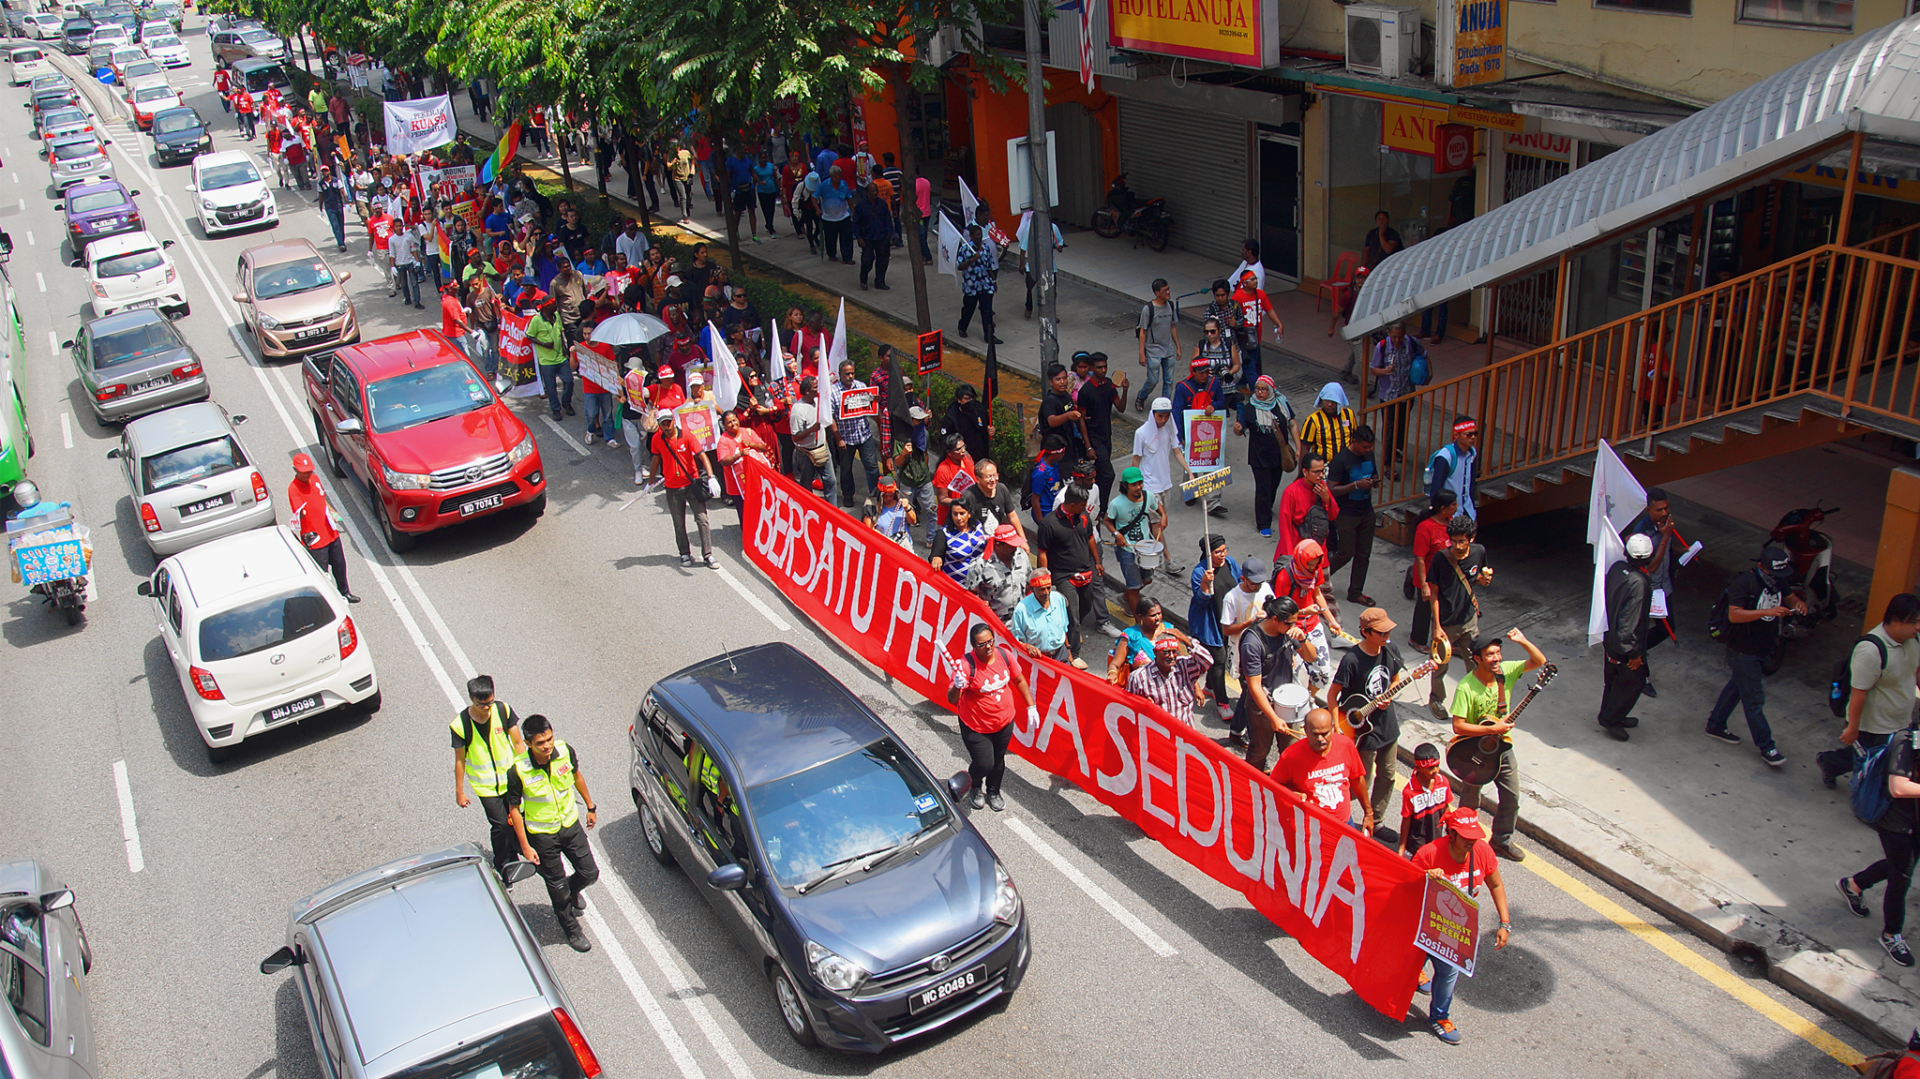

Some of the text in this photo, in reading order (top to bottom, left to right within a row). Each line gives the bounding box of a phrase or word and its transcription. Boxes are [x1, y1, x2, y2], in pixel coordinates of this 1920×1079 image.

[1118, 0, 1248, 29] HOTEL ANUJA
[1459, 0, 1501, 34] ANUJA
[1457, 44, 1503, 60] Ditubuhkan
[1459, 58, 1501, 76] Pada 1978
[411, 113, 447, 131] KUASA
[1456, 110, 1517, 129] WESTERN CUISINE
[1391, 114, 1444, 144] ANU
[1449, 143, 1466, 155] NIDA
[1194, 439, 1218, 447] BANGKIT
[1194, 445, 1218, 453] PEKERJA
[1190, 458, 1212, 466] Sosialis
[1194, 480, 1225, 498] BERDIAM
[188, 497, 224, 514] WLB 3454
[463, 496, 499, 513] WD 7074 E
[271, 698, 316, 720] BNJ 6098
[754, 475, 1366, 964] BERSATU PEKJA SEDUNIA
[1307, 762, 1346, 780] LAKSANAKAN
[1429, 910, 1472, 937] BANGKIT
[1429, 920, 1472, 947] PEKERJA
[1418, 932, 1459, 963] Sosialis
[921, 972, 975, 1006] WC 2049 G
